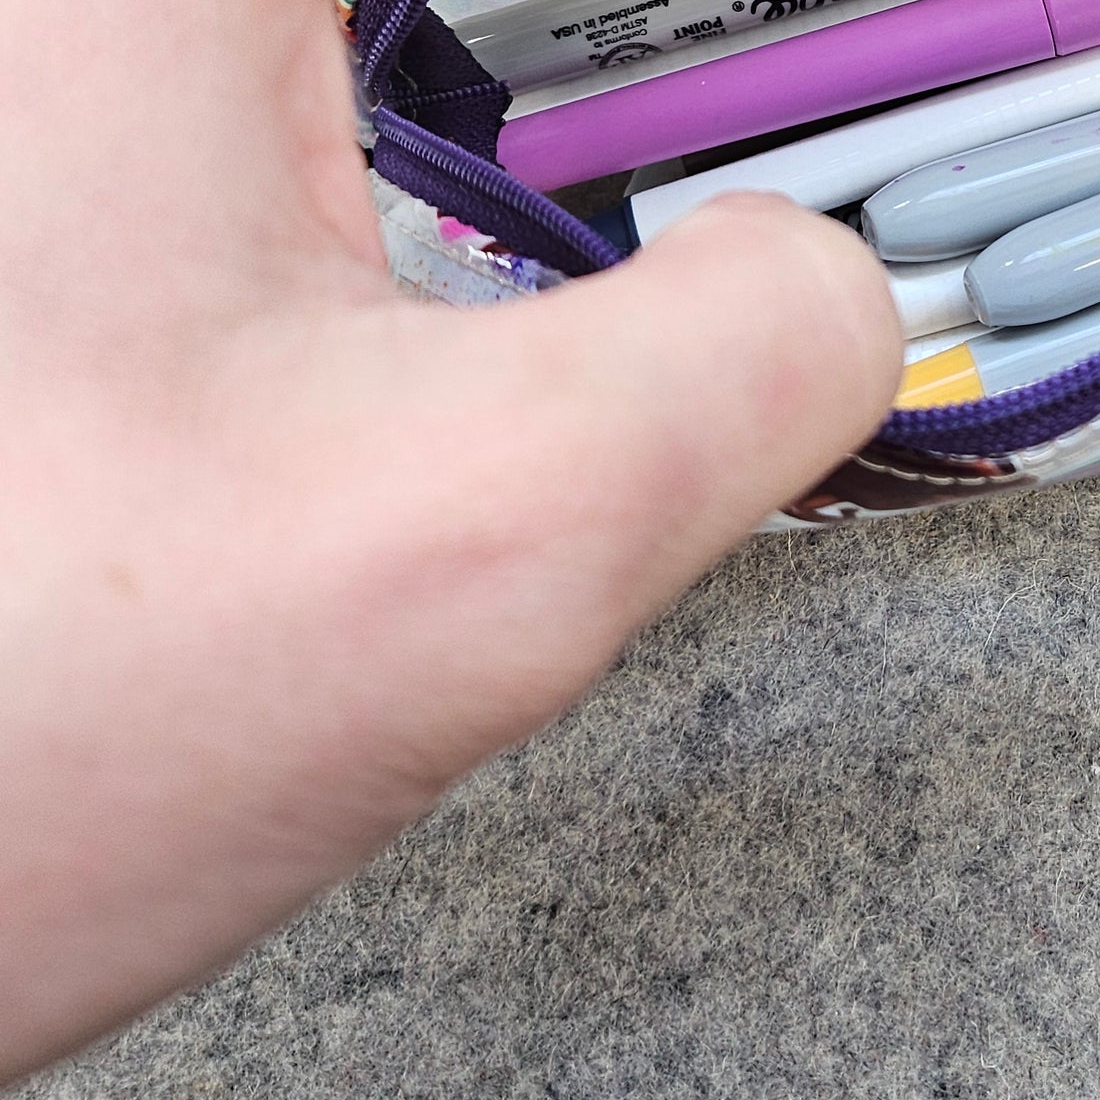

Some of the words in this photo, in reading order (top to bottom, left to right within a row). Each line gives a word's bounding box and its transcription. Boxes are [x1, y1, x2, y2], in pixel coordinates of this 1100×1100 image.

[583, 18, 596, 30] in
[620, 16, 648, 28] ASTM
[673, 15, 725, 41] POINT
[550, 27, 582, 41] USA
[604, 28, 648, 46] Conforms
[593, 38, 604, 49] to
